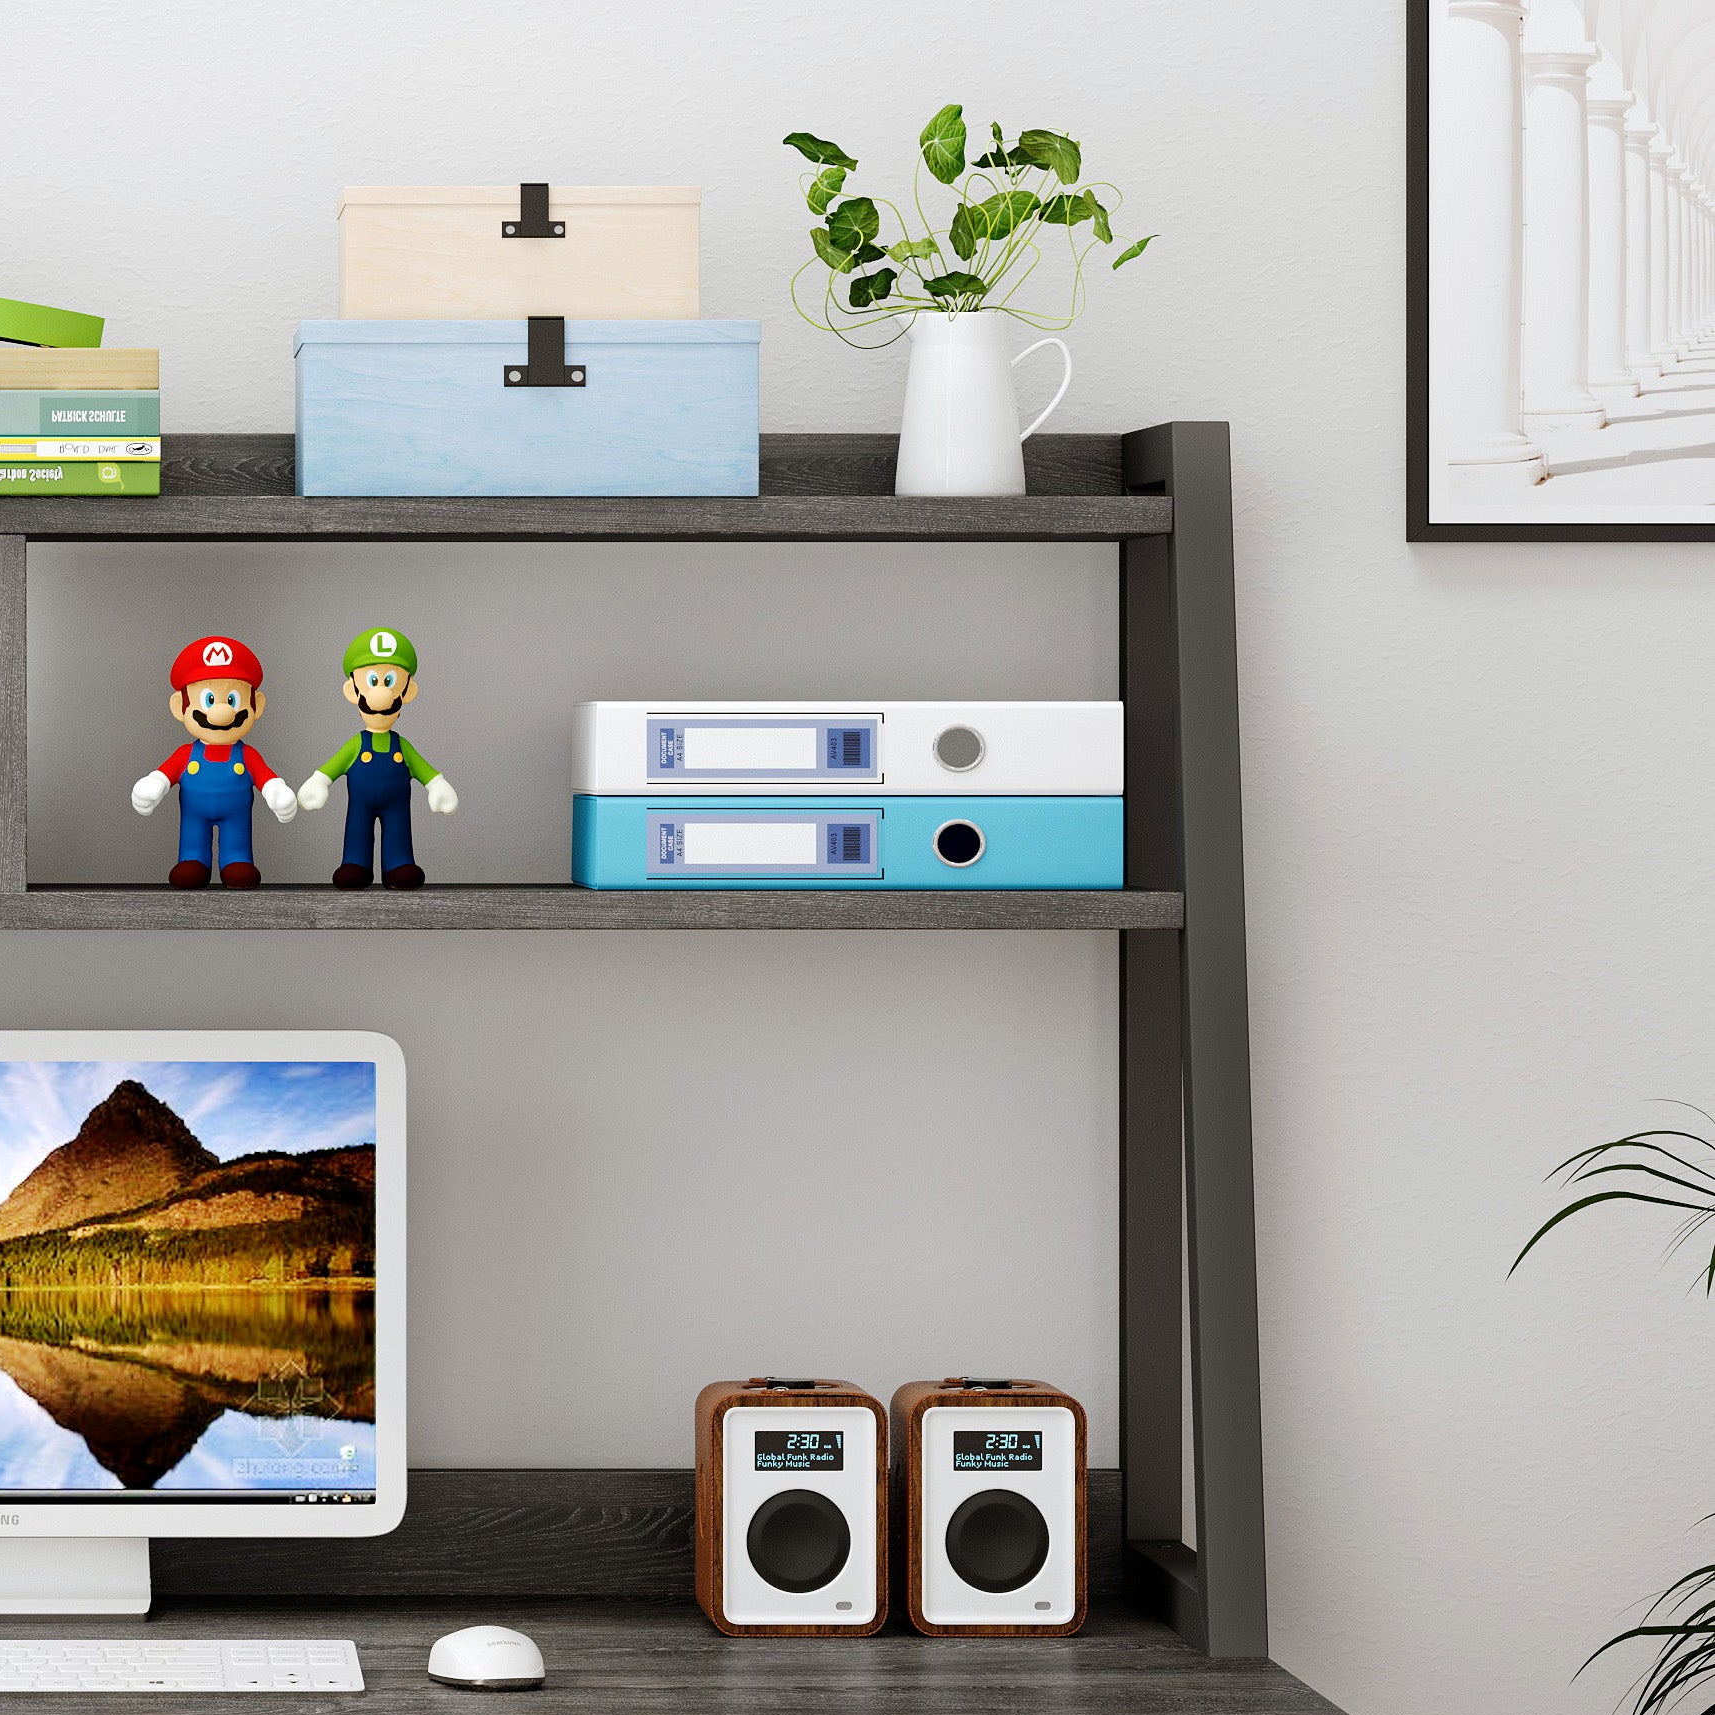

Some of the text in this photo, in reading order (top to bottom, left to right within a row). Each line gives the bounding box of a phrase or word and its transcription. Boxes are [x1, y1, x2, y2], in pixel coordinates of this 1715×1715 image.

[376, 634, 393, 653] L
[205, 646, 231, 663] M
[660, 732, 668, 764] DOCUMENT
[676, 753, 683, 762] A4
[660, 827, 668, 859] DOCUMENT
[787, 1433, 820, 1449] 2:30
[985, 1433, 1019, 1449] 2:30
[757, 1453, 834, 1461] Global Funk Radio
[757, 1460, 810, 1469] Funky Music
[956, 1453, 1033, 1461] Global Funk Radio
[956, 1460, 1009, 1469] Funky Music
